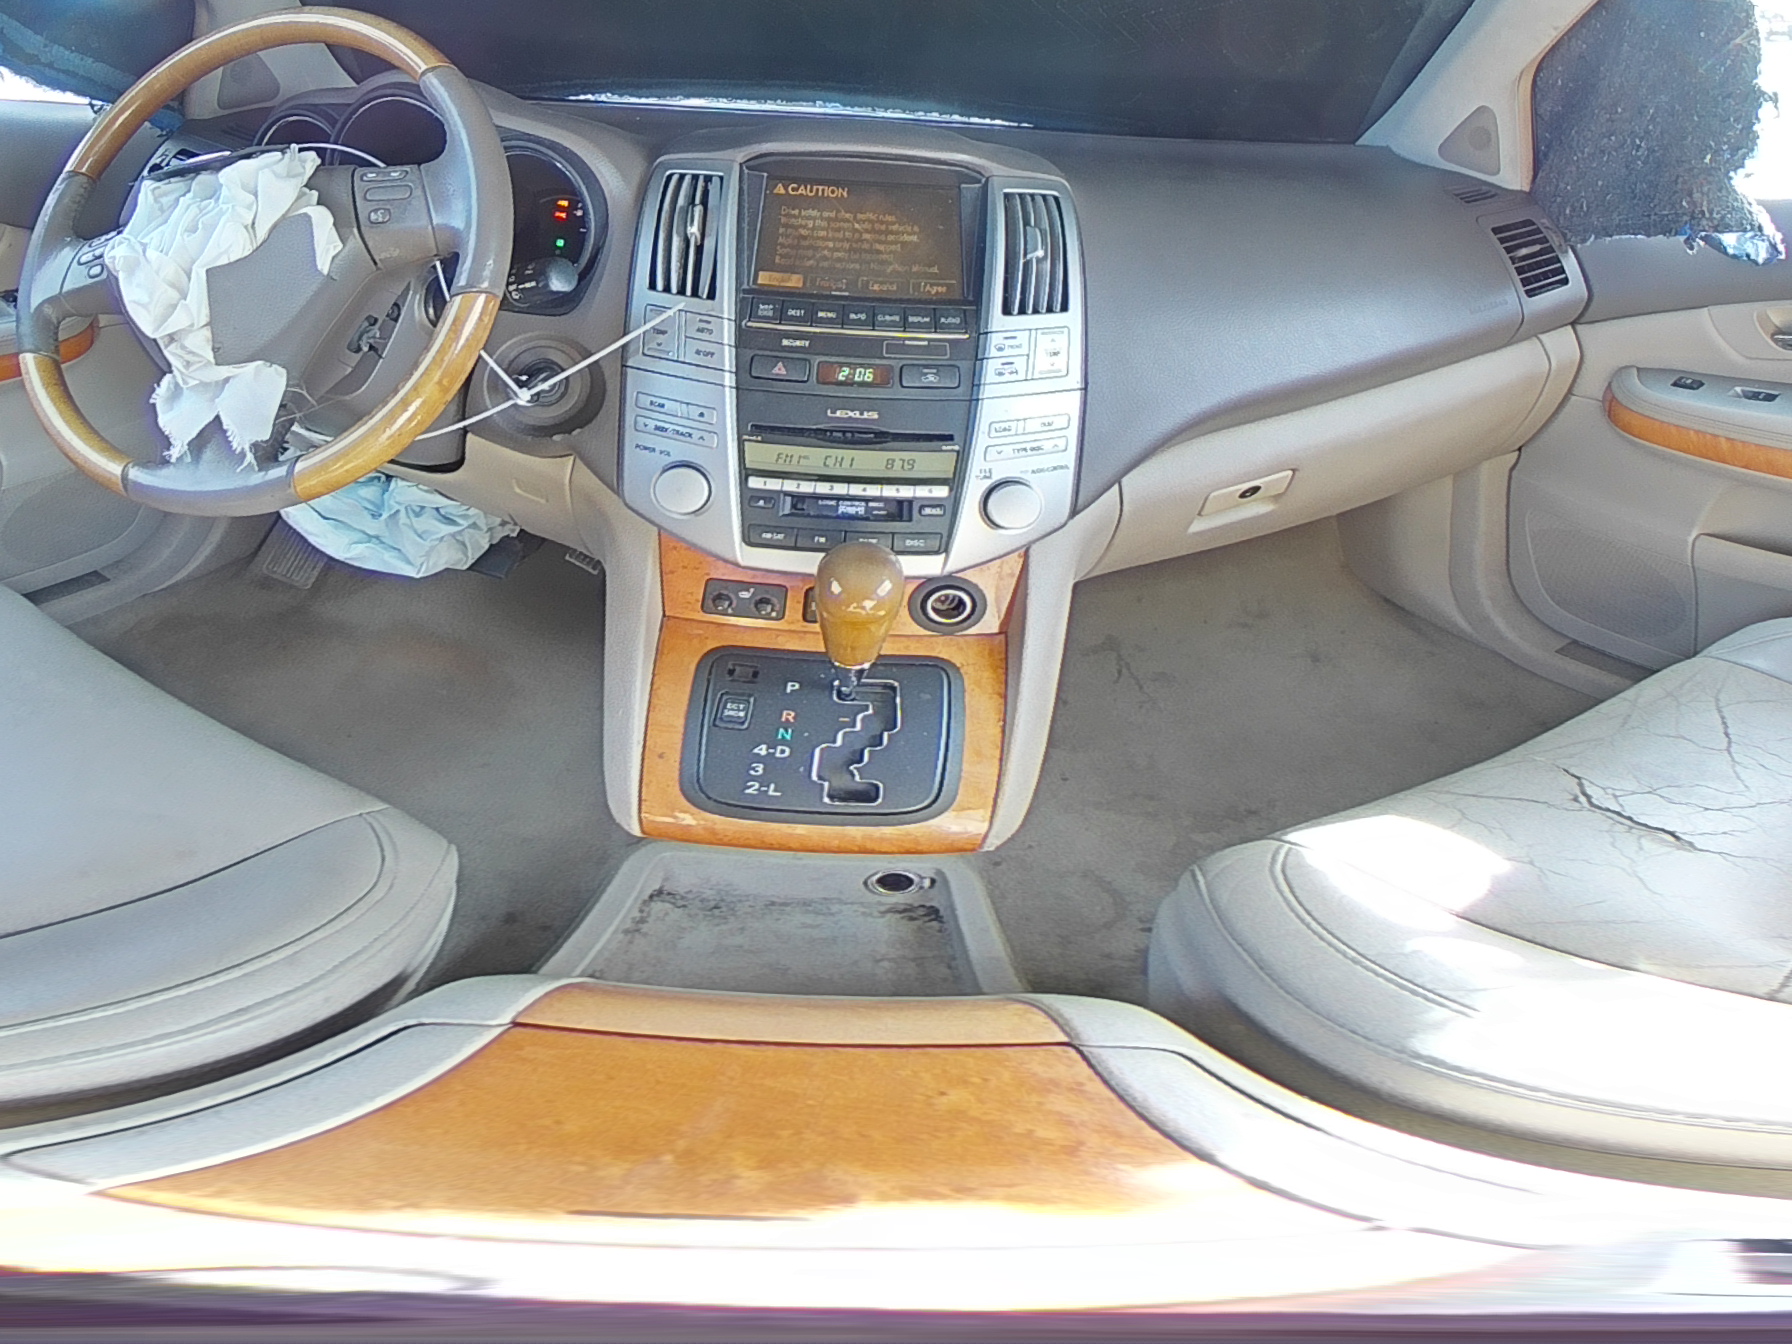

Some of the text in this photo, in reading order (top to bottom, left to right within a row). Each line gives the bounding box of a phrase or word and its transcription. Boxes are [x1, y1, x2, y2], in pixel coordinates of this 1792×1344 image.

[787, 184, 848, 198] CAUTION
[781, 206, 799, 216] Drive
[822, 209, 836, 217] and
[815, 219, 828, 227] this
[874, 222, 886, 230] the
[869, 281, 897, 291] Español
[925, 282, 947, 294] Agree
[787, 308, 805, 317] DEST
[817, 310, 836, 319] MENU
[939, 316, 961, 325] AUDIO
[837, 366, 874, 382] 2:06
[827, 408, 879, 419] LEXUS
[905, 539, 925, 547] DISC
[786, 682, 801, 694] P
[781, 710, 796, 722] R
[777, 728, 793, 740] N
[752, 744, 791, 758] 4-D
[749, 763, 764, 775] 3
[744, 781, 782, 796] 2-L
